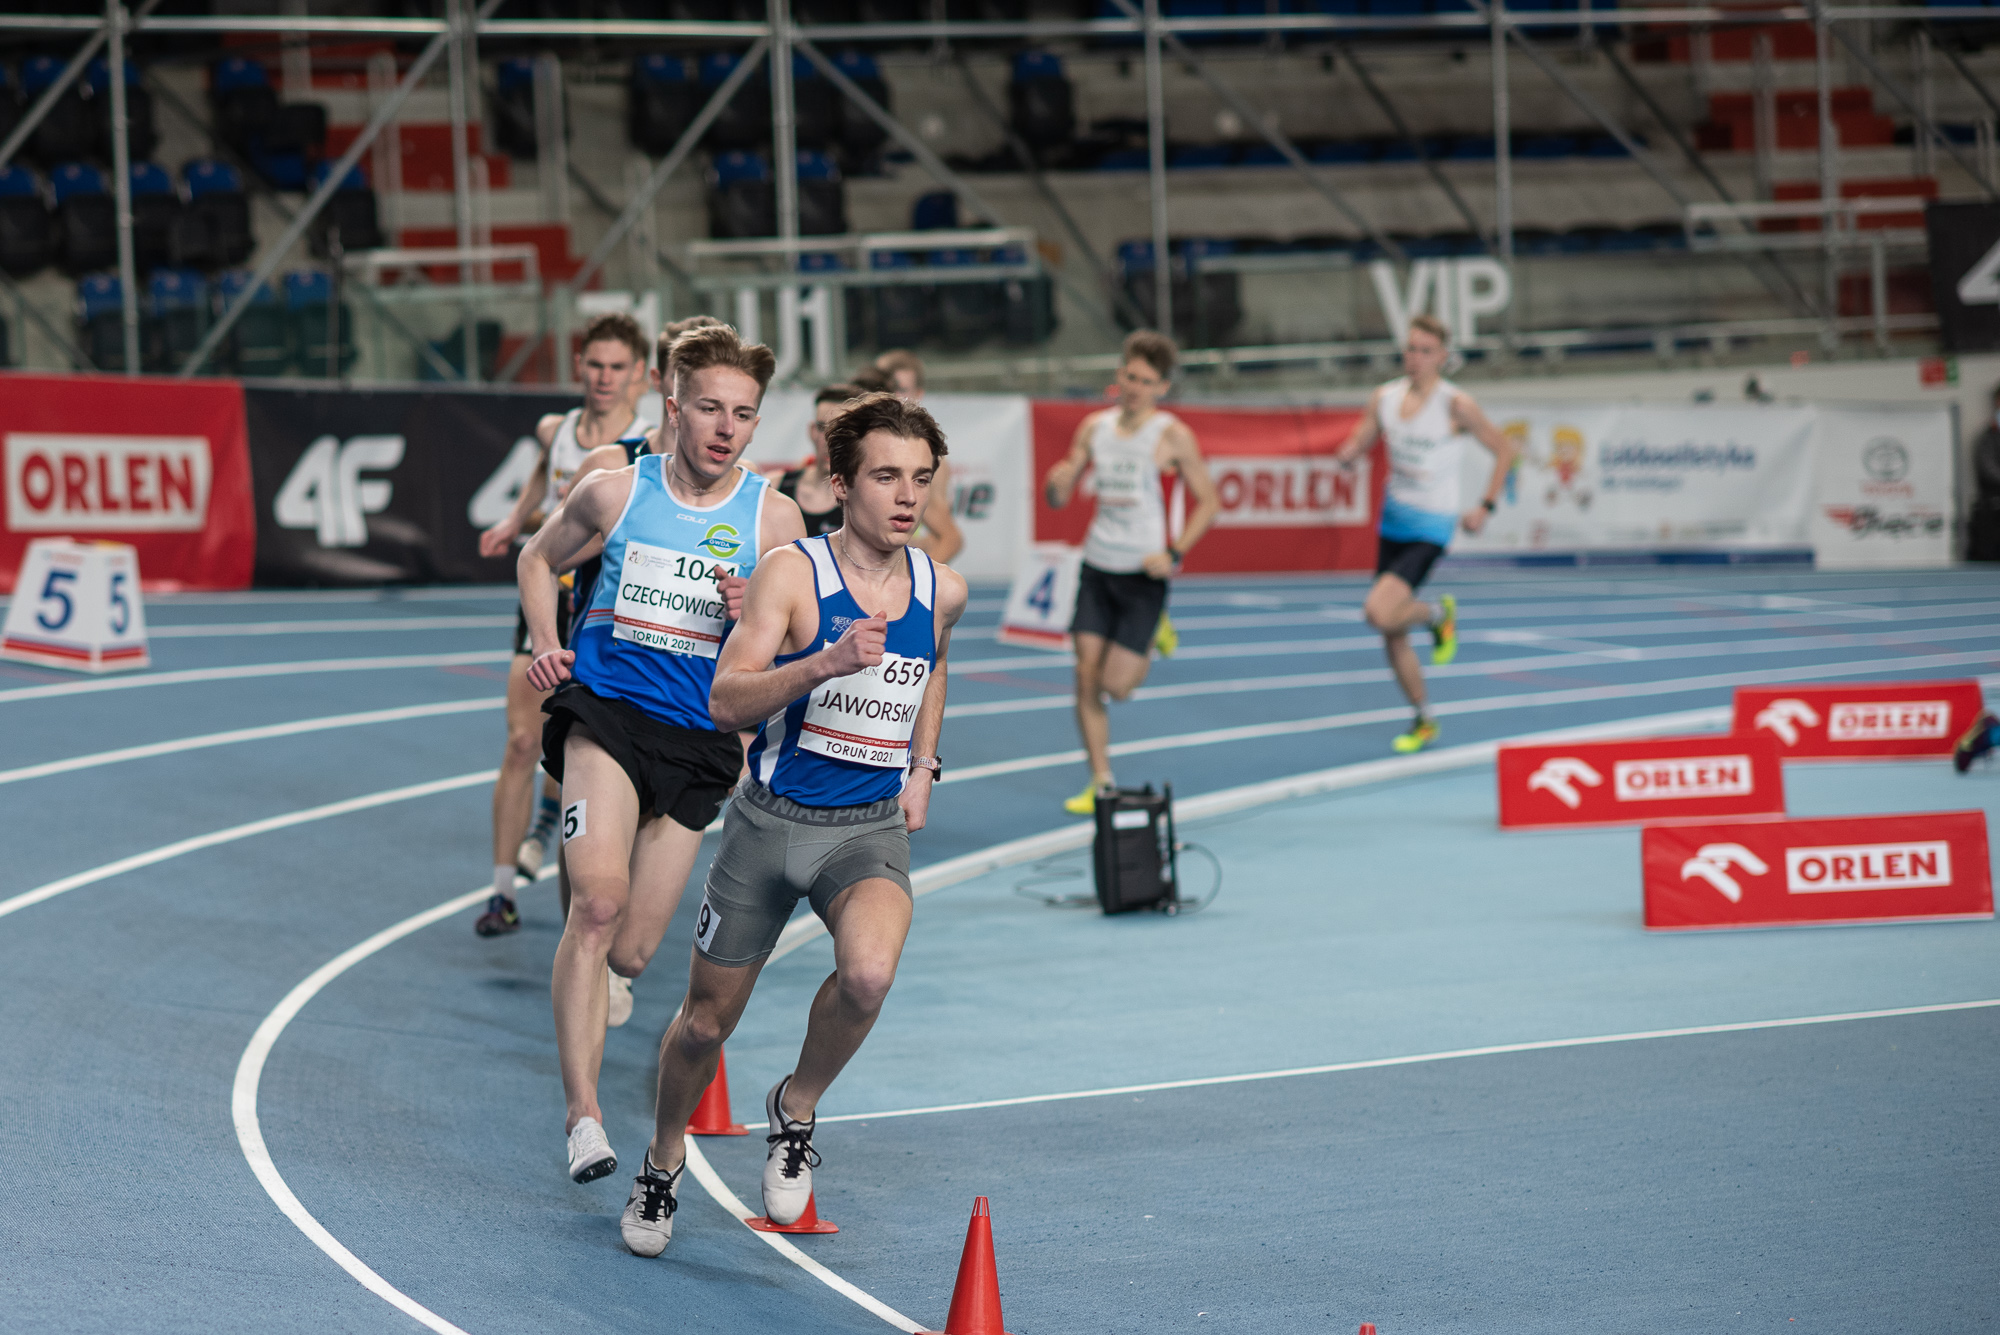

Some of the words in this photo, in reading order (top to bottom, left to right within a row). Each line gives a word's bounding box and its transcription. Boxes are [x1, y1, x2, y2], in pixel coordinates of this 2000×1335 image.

[1371, 257, 1511, 350] VIP
[20, 450, 196, 514] ORLEN
[274, 434, 405, 547] 4F
[1218, 470, 1356, 513] ORLEN
[36, 567, 77, 630] 5
[110, 572, 130, 635] 5
[622, 583, 725, 620] CZECHOWICZ
[1028, 567, 1056, 621] 4
[633, 629, 668, 646] TORUŃ
[671, 638, 696, 652] 2021
[883, 660, 925, 687] 659
[818, 690, 916, 723] JAWORSKI
[1840, 705, 1940, 731] ORLEN
[826, 741, 868, 759] TORUŃ
[870, 750, 893, 763] 2021
[1626, 763, 1741, 790] ORLEN
[564, 804, 578, 839] 5
[771, 797, 827, 823] NIKE
[832, 801, 883, 823] PRO
[1797, 850, 1939, 883] ORLEN
